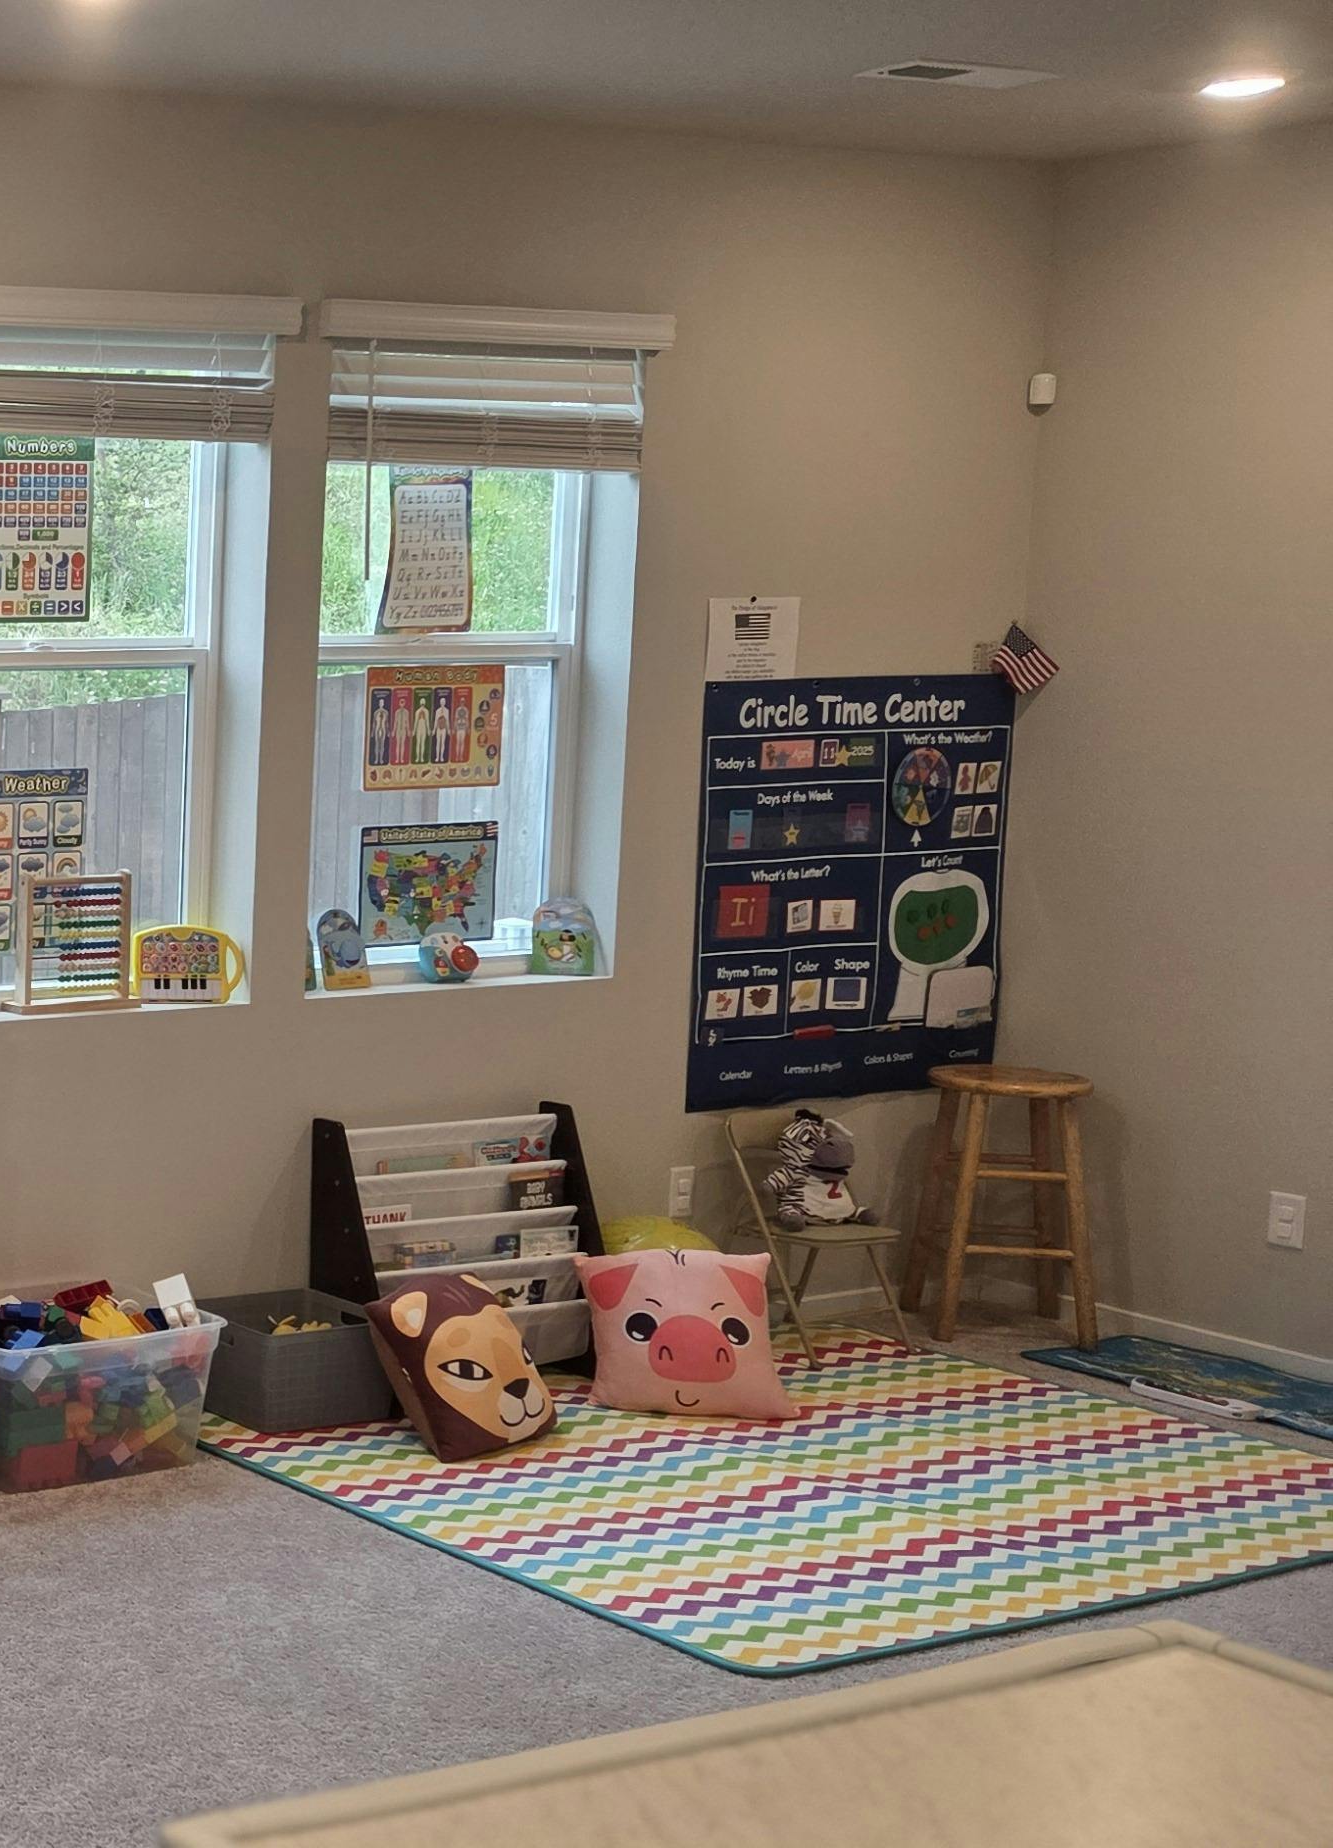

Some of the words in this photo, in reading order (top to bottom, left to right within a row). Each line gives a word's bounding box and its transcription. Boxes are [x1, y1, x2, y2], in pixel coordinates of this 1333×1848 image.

[6, 439, 75, 454] Numbers
[395, 670, 439, 682] Human
[447, 670, 477, 681] Body
[740, 695, 809, 729] Circle
[816, 695, 878, 726] Time
[884, 693, 965, 724] Center
[490, 714, 497, 726] 5
[904, 734, 935, 744] What's
[937, 734, 953, 744] the
[955, 732, 993, 744] Weather?
[823, 747, 835, 760] 11
[851, 746, 874, 756] 2025
[715, 758, 745, 772] Today
[747, 758, 756, 768] is
[5, 776, 67, 792] Weather
[757, 792, 782, 805] Days
[783, 792, 792, 803] of
[793, 792, 806, 802] the
[808, 791, 833, 802] Week
[381, 830, 409, 840] United
[411, 828, 435, 838] States
[438, 829, 446, 838] of
[450, 827, 481, 836] America
[921, 856, 941, 868] Let's
[943, 855, 963, 866] Count
[751, 870, 786, 882] What's
[787, 869, 799, 880] the
[801, 865, 831, 879] Letter?
[731, 898, 755, 926] Ii
[795, 961, 819, 973] Color
[834, 958, 870, 972] Shape
[716, 967, 750, 980] Rhyme
[752, 966, 778, 977] Time
[863, 1055, 886, 1065] Colors
[886, 1054, 892, 1063] &
[719, 1069, 752, 1081] Calendar
[784, 1064, 812, 1075] Letters
[813, 1064, 820, 1073] &
[527, 1182, 545, 1194] BABY
[364, 1212, 407, 1225] THANK
